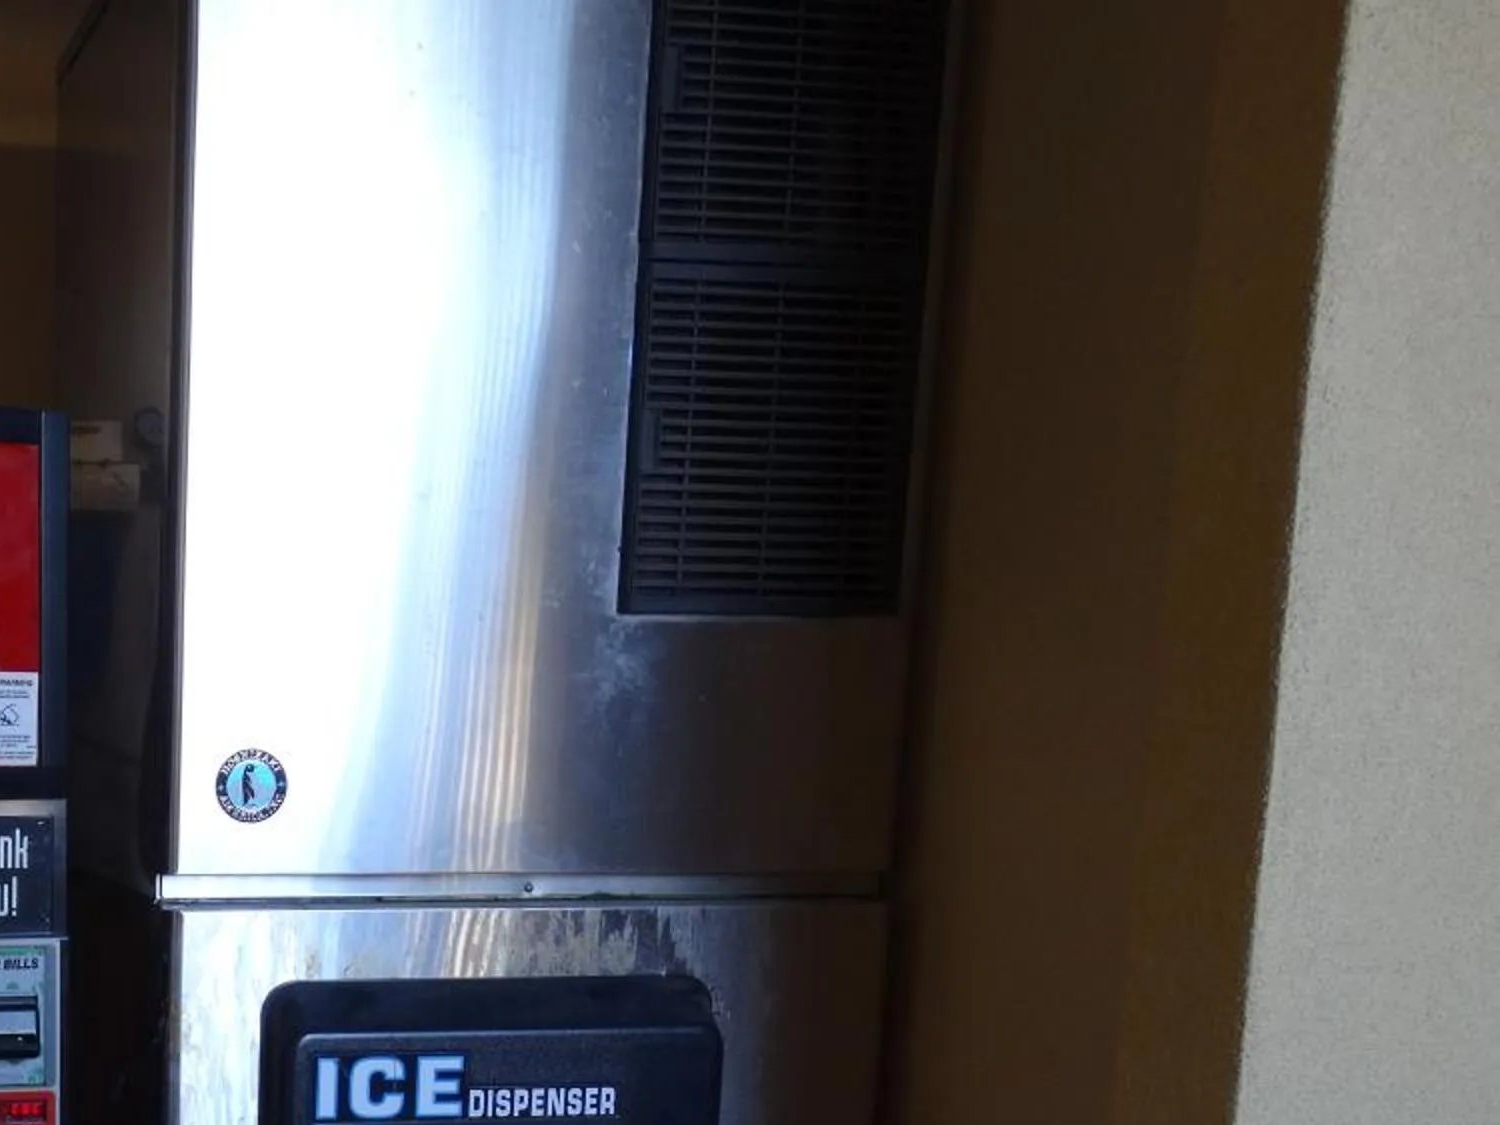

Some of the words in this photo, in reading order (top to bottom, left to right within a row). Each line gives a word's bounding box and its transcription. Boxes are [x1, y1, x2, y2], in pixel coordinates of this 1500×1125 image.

[3, 957, 39, 970] BILLS
[315, 1054, 464, 1119] ICE
[467, 1086, 617, 1118] DISPENSER
